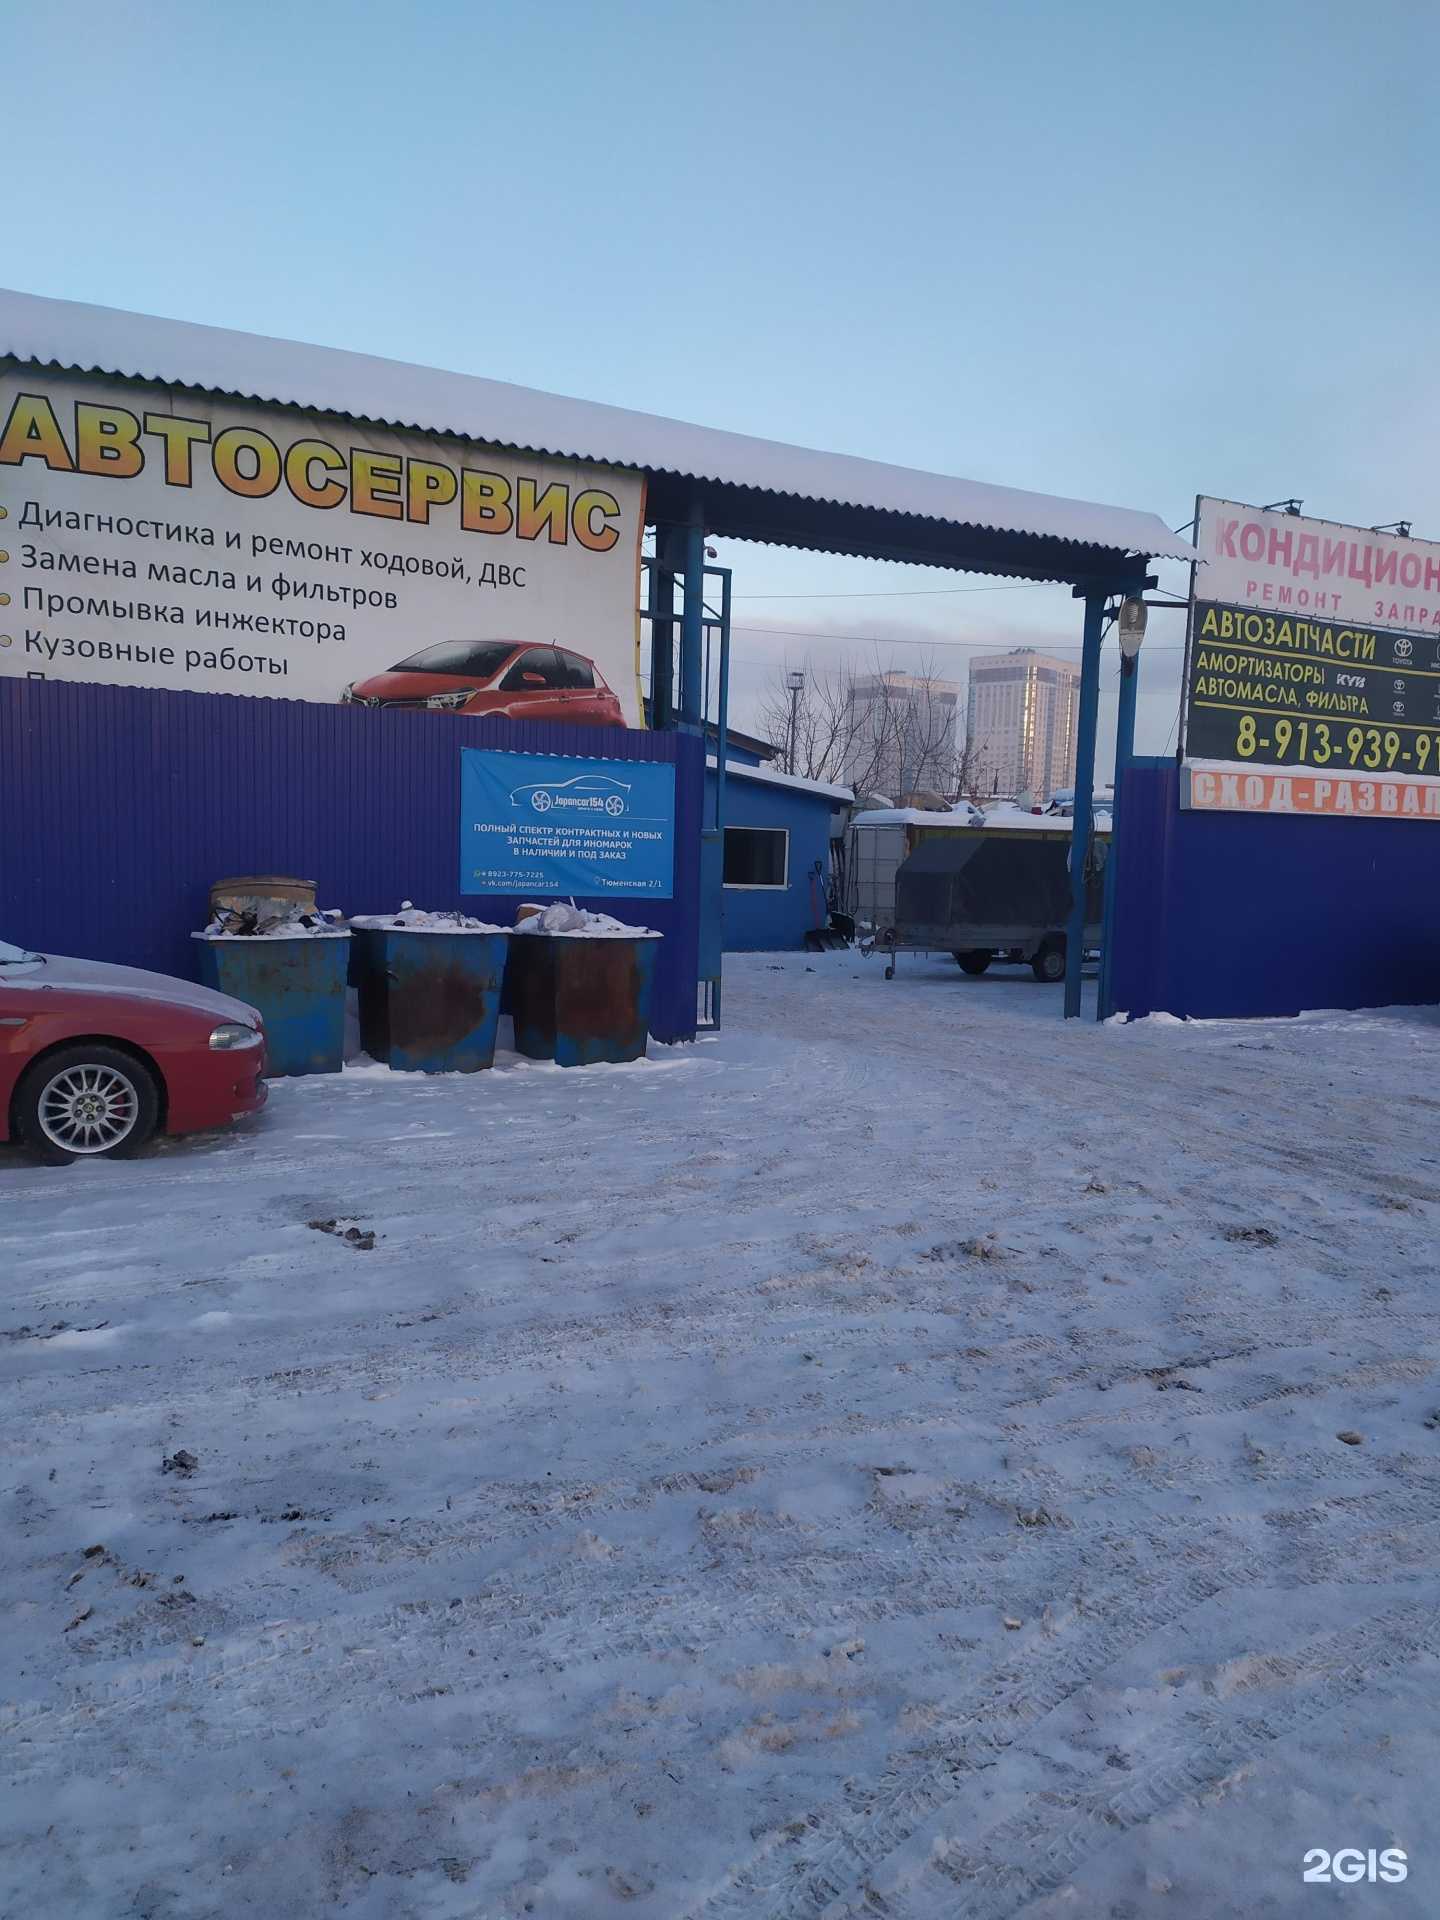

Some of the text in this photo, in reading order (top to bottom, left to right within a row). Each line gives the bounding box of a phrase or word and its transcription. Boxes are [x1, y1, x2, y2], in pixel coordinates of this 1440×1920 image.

[0, 392, 621, 552] АВТОСЕРВИС
[18, 501, 527, 589] Диагностика и ремонт ходовой, ДВС
[21, 544, 398, 610] Замена масла и фильтров
[1246, 579, 1342, 612] РЕМОНТ
[23, 586, 346, 644] Промывка инжектора
[1201, 608, 1376, 661] АВТОЗАПЧАСТИ
[25, 629, 289, 676] Кузовные работы
[1196, 651, 1326, 686] АМОРТИЗАТОРЫ
[1305, 690, 1369, 715] ФИЛЬТРА
[473, 823, 517, 833] ПОЛНЫЙ
[519, 825, 554, 835] СПЕКТР
[555, 827, 621, 838] КОНТРАКТНЫХ
[631, 831, 663, 840] НОВЫХ
[506, 836, 633, 849] ЗАПЧАСТЕЙ ДЛЯ ИНОМАРОК
[513, 848, 626, 860] В НАЛИЧИИ И ПОД ЗАКАЗ
[601, 879, 647, 887] Тюменская
